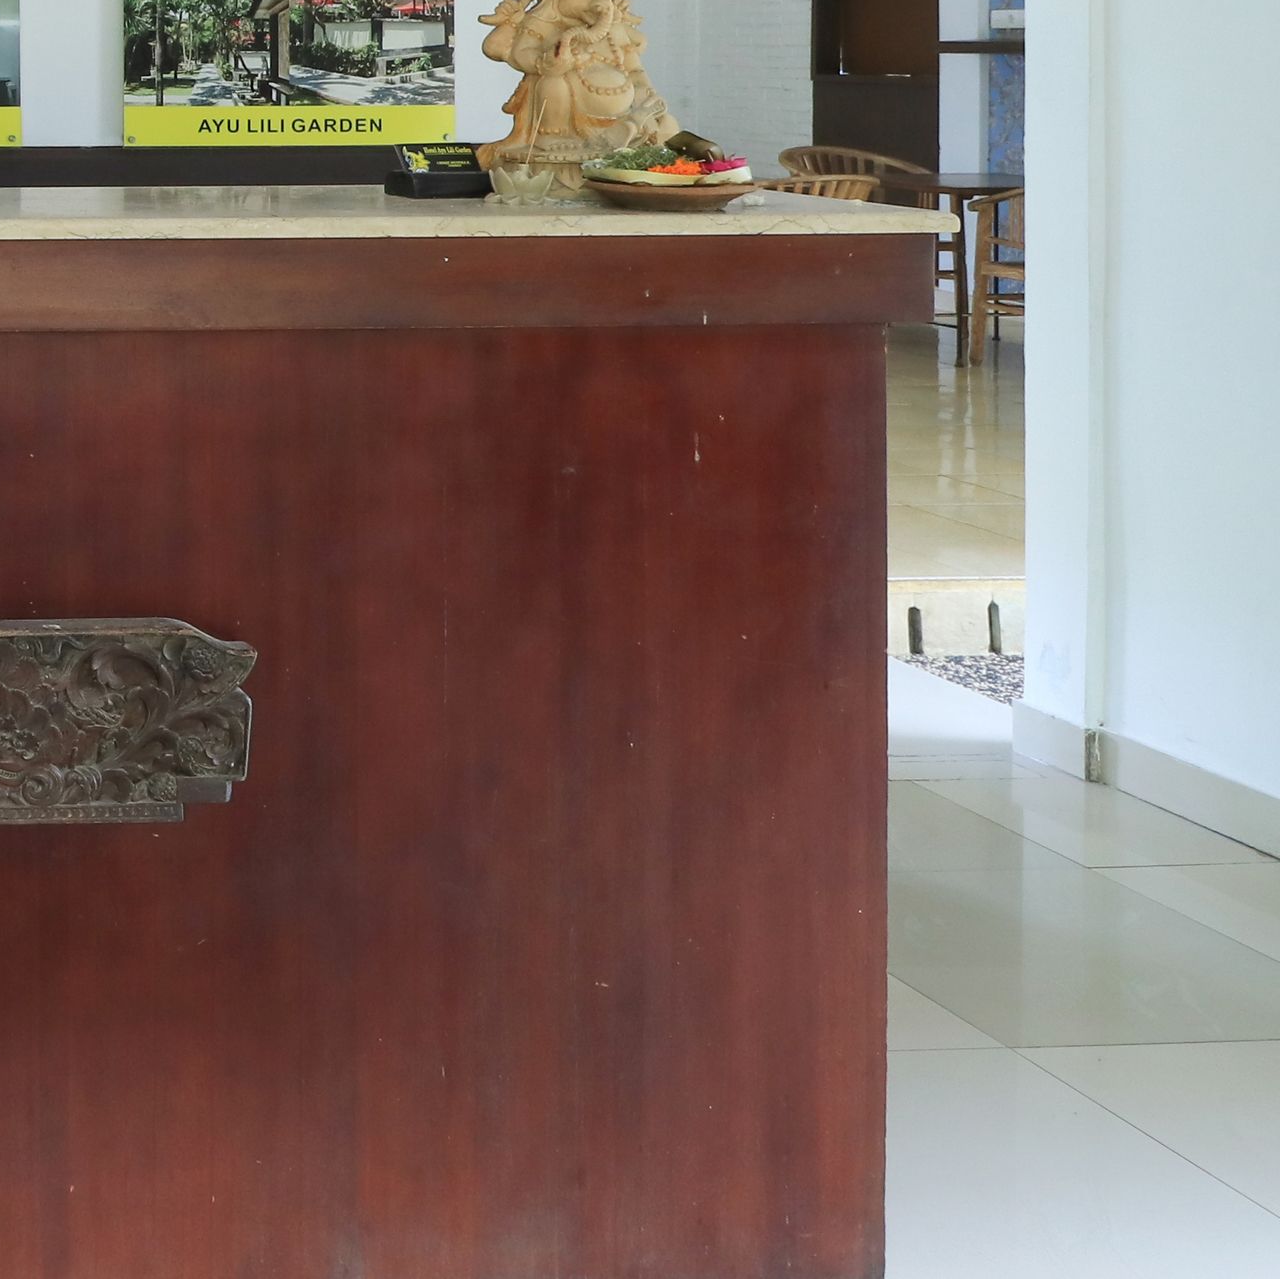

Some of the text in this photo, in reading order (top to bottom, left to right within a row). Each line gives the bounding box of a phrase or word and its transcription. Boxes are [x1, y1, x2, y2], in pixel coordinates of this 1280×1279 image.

[198, 118, 382, 133] AYU LILI GARDEN
